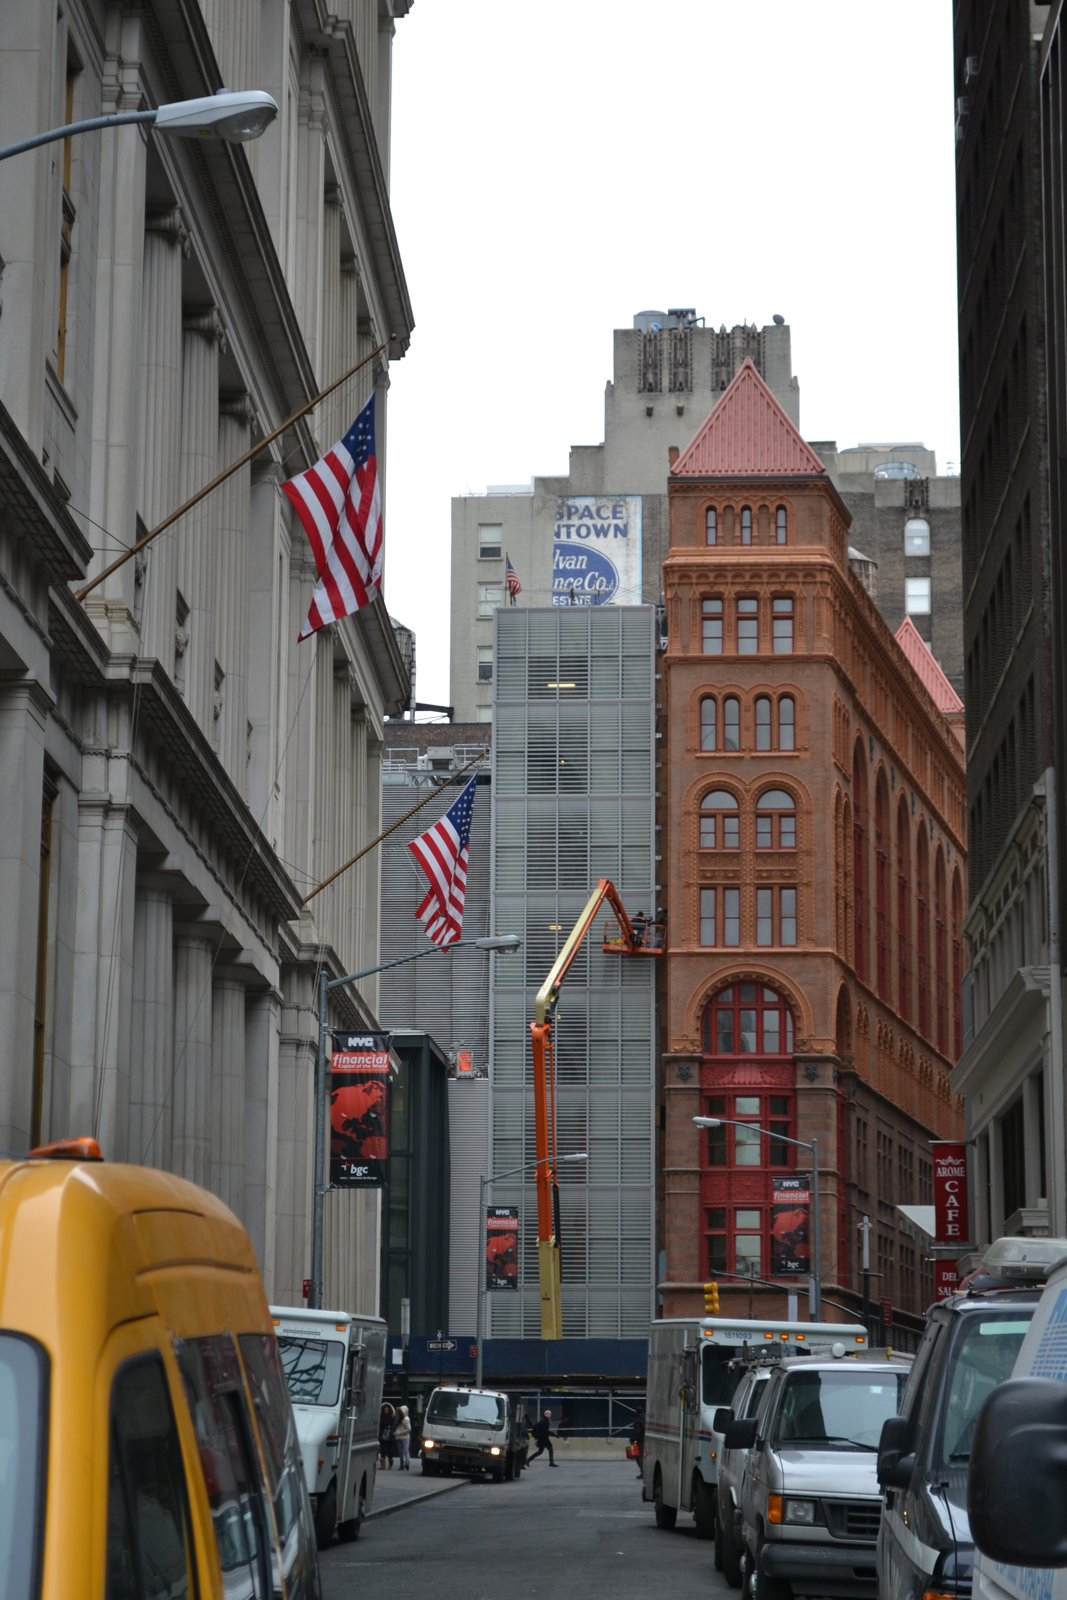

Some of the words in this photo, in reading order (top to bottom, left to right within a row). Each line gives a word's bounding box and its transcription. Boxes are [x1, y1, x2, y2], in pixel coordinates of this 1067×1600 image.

[347, 1037, 374, 1047] NYC
[333, 1054, 388, 1067] financial
[350, 1163, 368, 1176] bgc
[936, 1166, 965, 1177] AROME
[945, 1181, 960, 1235] CAFE
